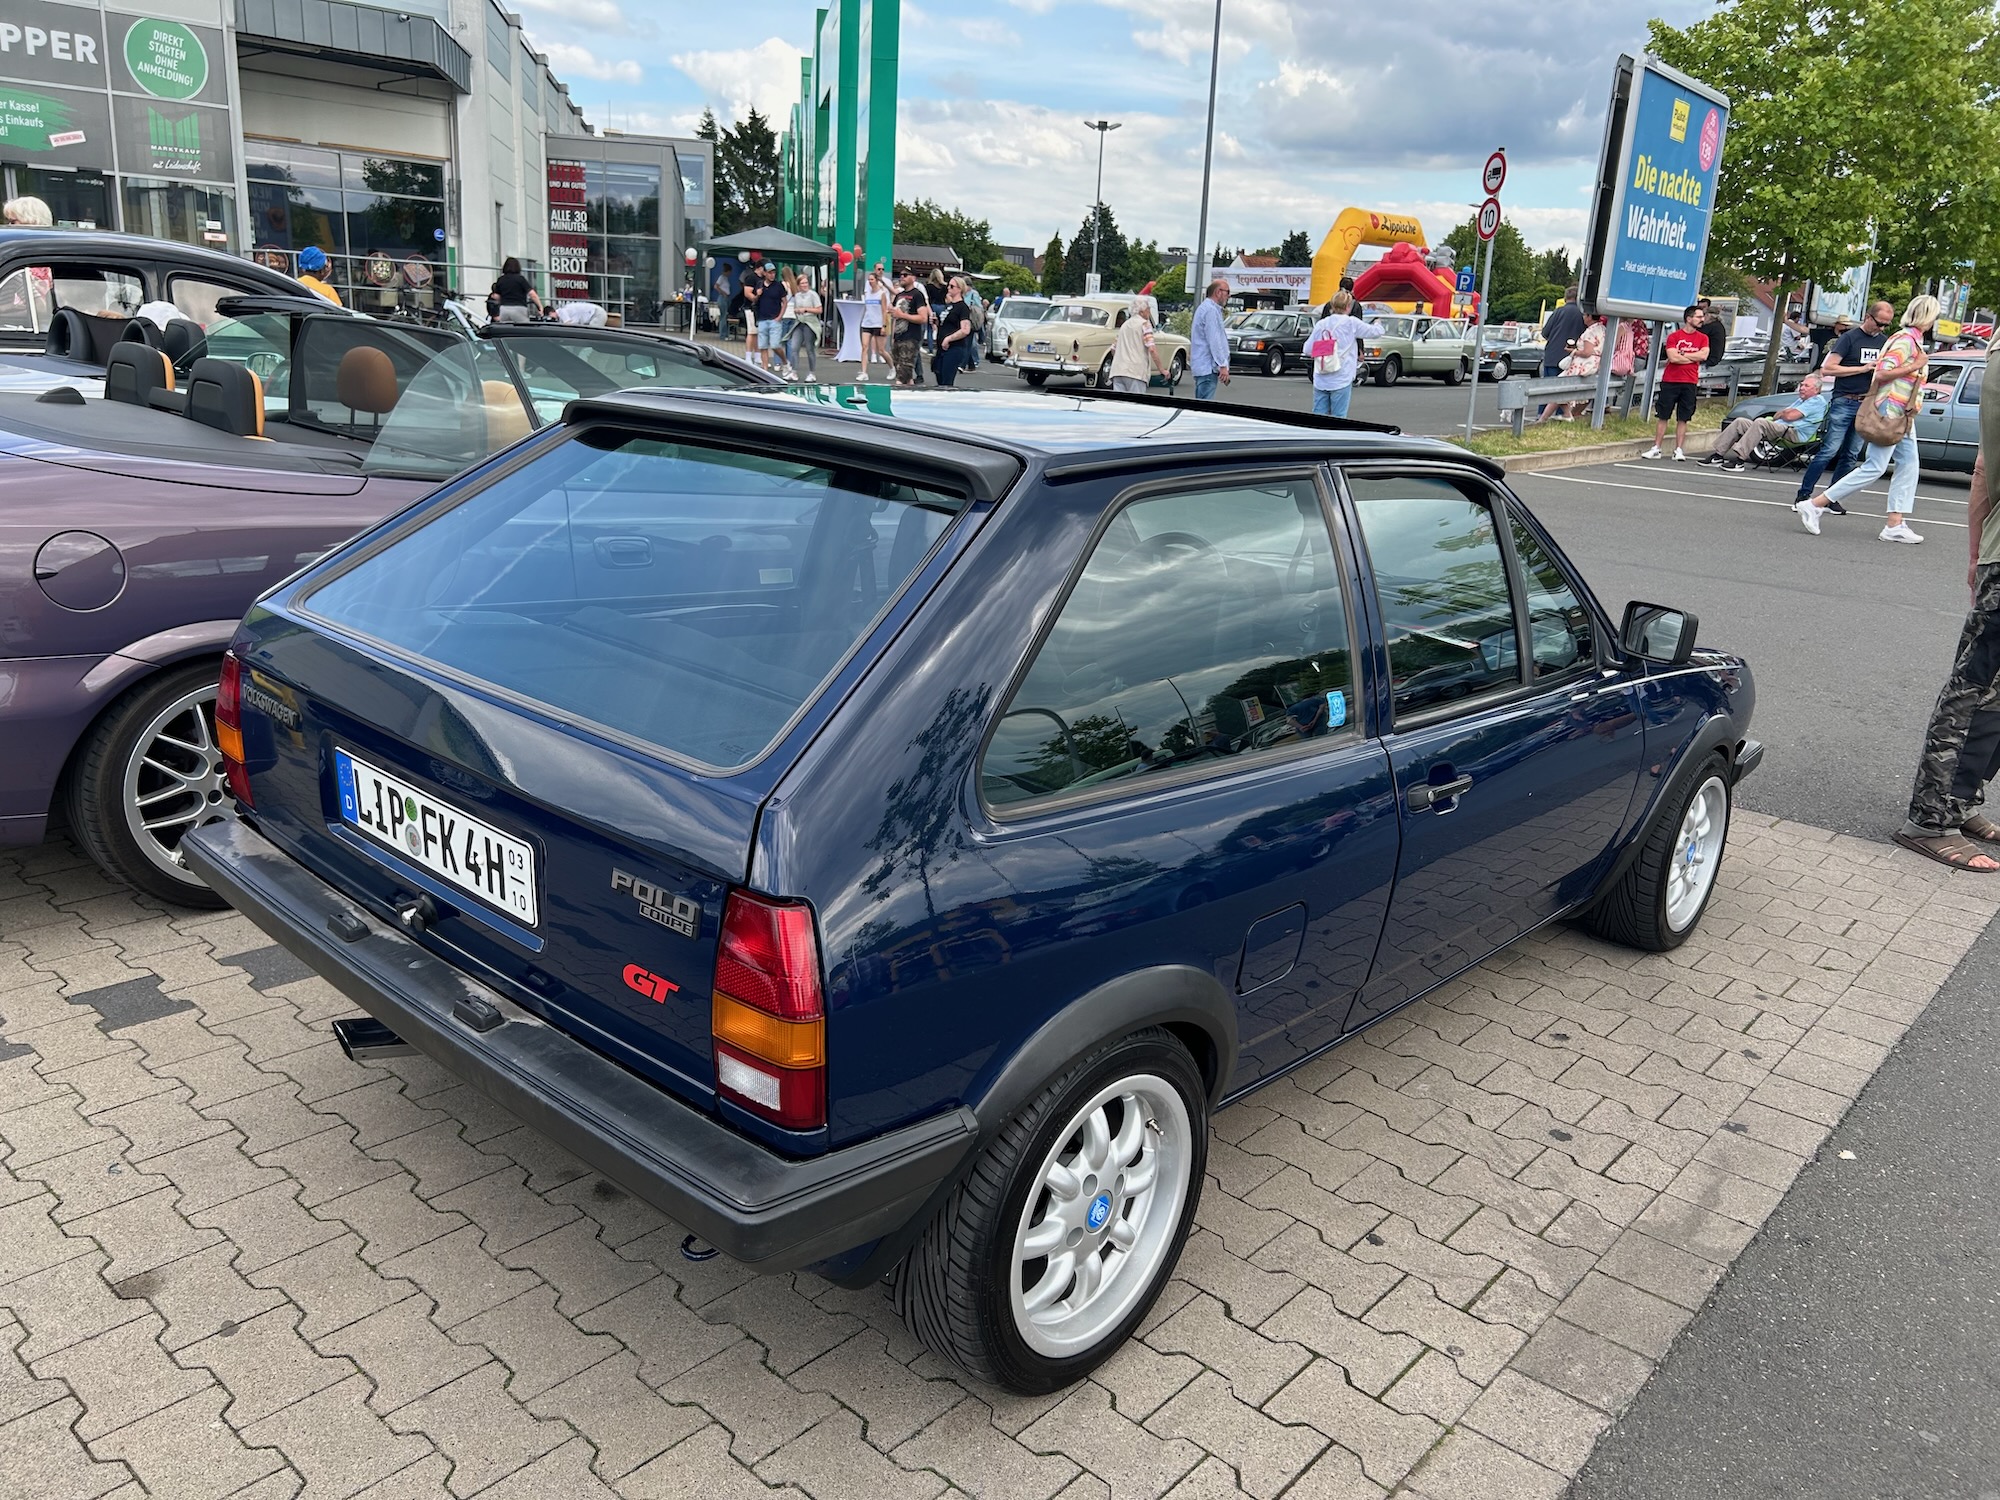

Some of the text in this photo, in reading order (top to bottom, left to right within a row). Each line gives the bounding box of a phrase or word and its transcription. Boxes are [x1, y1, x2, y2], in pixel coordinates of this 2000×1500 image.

[153, 29, 185, 49] DIREKT
[148, 40, 187, 61] STARTEN
[154, 54, 179, 71] OHNE
[137, 61, 194, 87] ANMELDUNG!
[8, 99, 40, 113] Kasse!
[5, 113, 45, 128] Einkaufs
[150, 145, 201, 155] MARKTKAUF
[549, 180, 561, 188] UND
[562, 181, 570, 189] AN
[1633, 154, 1702, 207] Die nackte
[550, 220, 588, 232] MINUTEN
[551, 209, 588, 223] ALLE 30
[1380, 215, 1417, 237] Lippische
[1483, 209, 1495, 229] 10
[1627, 203, 1687, 249] Wahrheit
[550, 246, 588, 257] GEBACKEN
[551, 257, 588, 273] BROT
[1235, 275, 1274, 287] Legenden
[1275, 276, 1284, 284] in
[1284, 275, 1307, 287] Lippe
[1459, 274, 1471, 291] P
[1864, 351, 1878, 359] HH
[243, 683, 298, 727] VOLKSWAGEN
[344, 794, 354, 811] D
[353, 768, 506, 901] LIP FK 4H
[508, 849, 524, 870] 03
[512, 890, 527, 911] 10
[611, 867, 701, 923] POLO
[639, 903, 694, 937] COUPE
[622, 963, 681, 1004] GT
